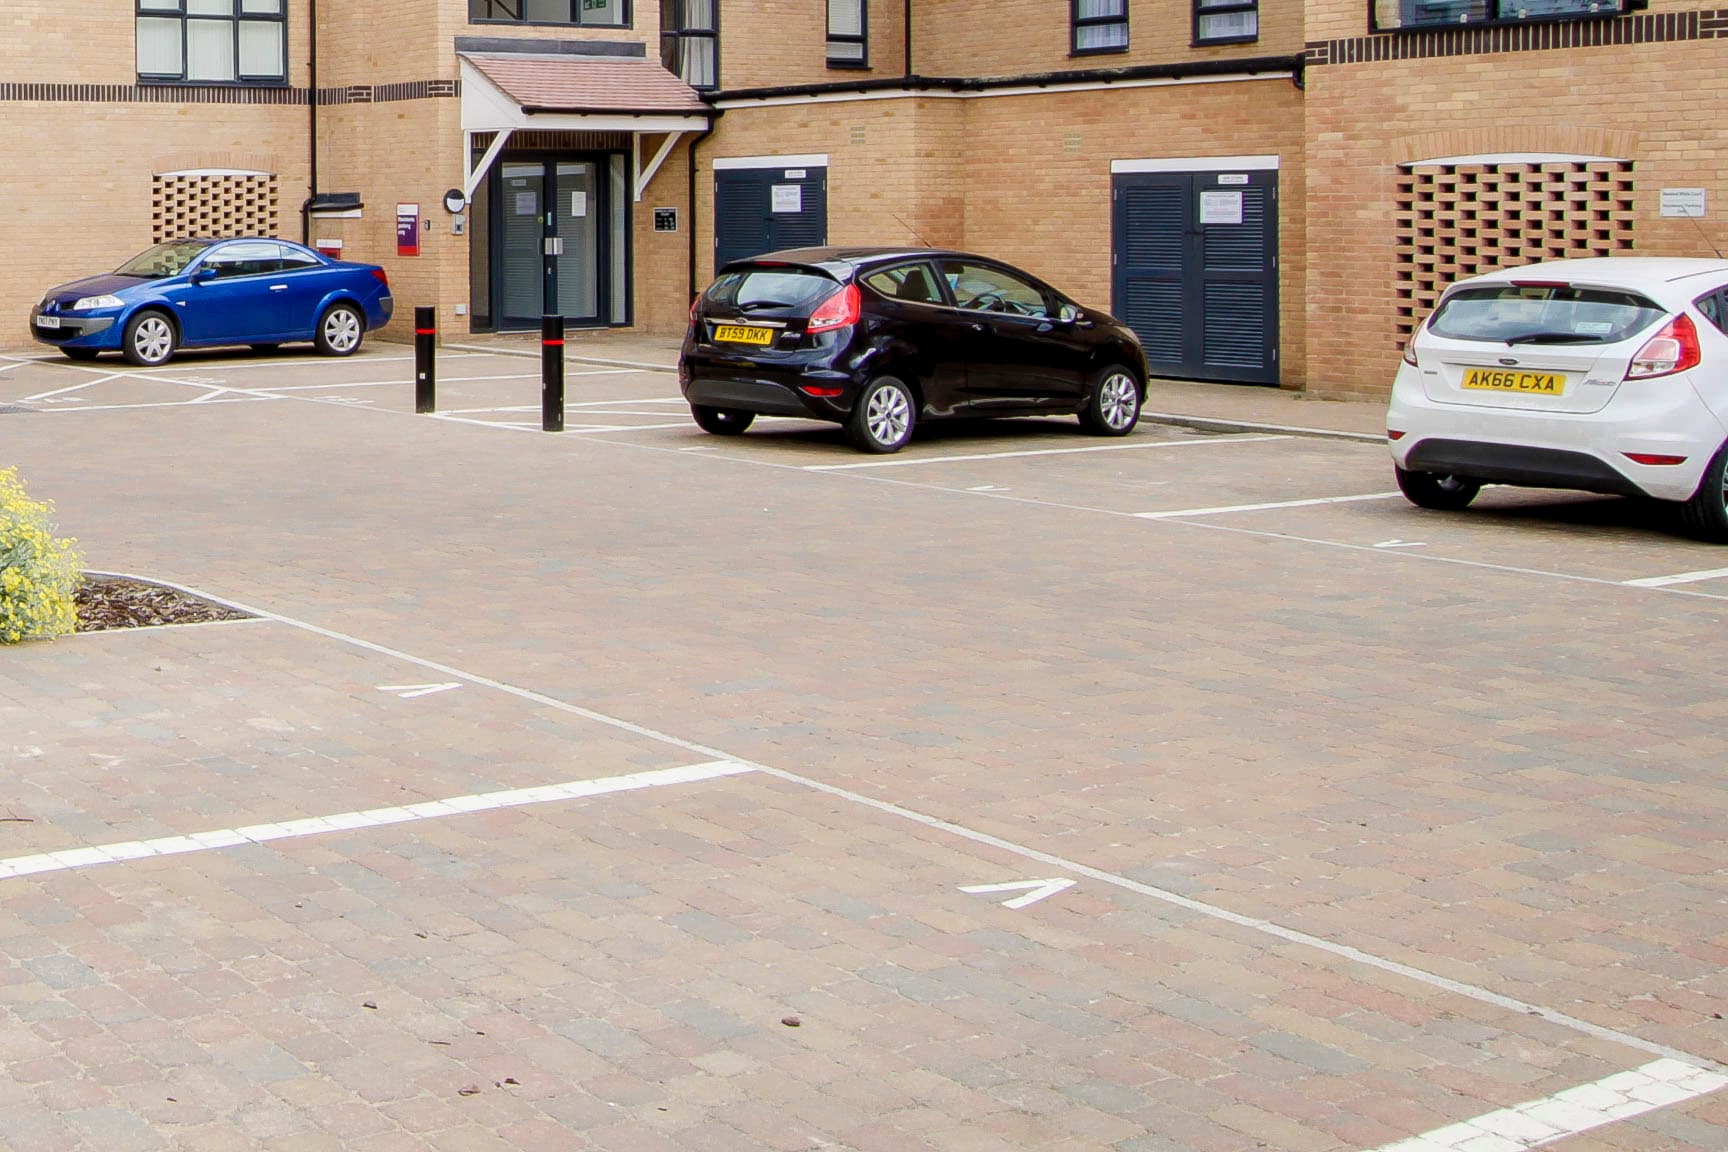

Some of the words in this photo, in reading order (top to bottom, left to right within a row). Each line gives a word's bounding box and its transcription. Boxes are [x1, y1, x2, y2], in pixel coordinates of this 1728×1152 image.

[719, 327, 745, 340] BT59
[746, 328, 769, 341] DKK
[1468, 371, 1514, 388] AK66
[1521, 374, 1555, 390] CXA
